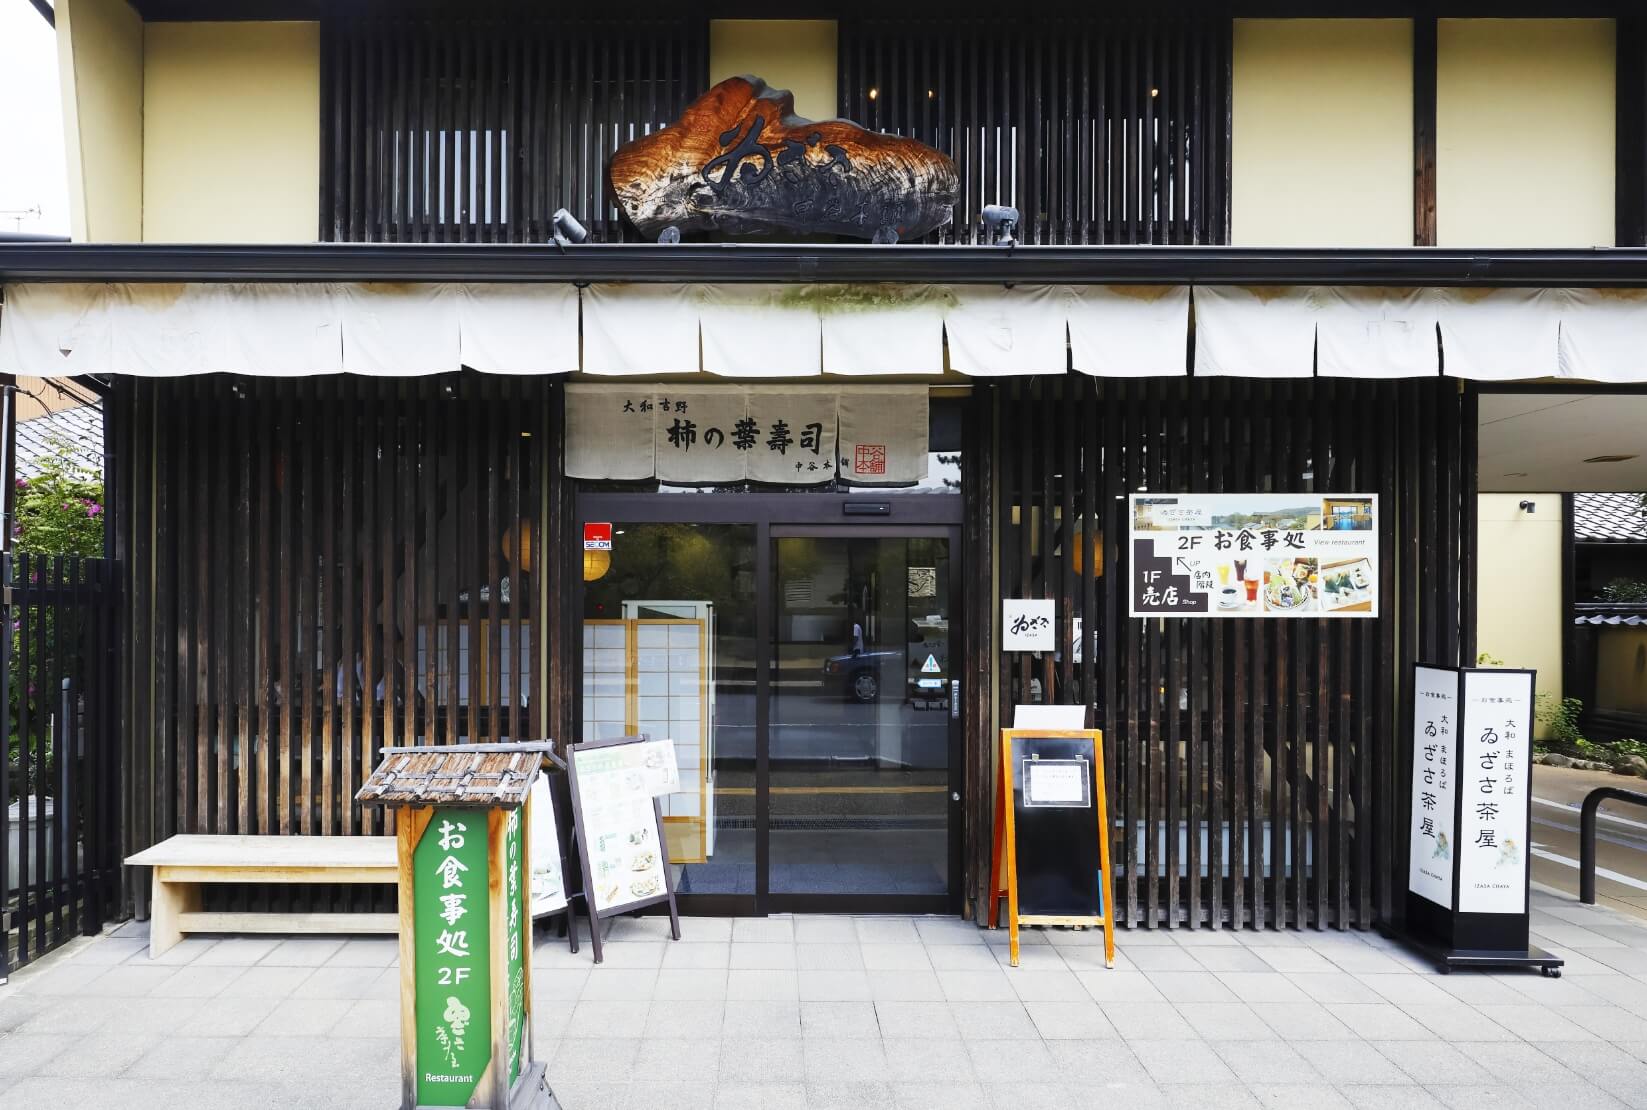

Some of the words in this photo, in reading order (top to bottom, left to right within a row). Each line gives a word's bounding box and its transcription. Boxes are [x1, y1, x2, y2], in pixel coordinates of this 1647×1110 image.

[623, 397, 688, 414] 大和吉野
[1177, 535, 1203, 550] 2F
[1213, 529, 1306, 551] お食事処
[1142, 570, 1162, 583] 1F
[1142, 585, 1178, 606] 売店
[1504, 719, 1516, 740] 大和
[1420, 720, 1438, 839] ゐざさ茶屋
[1503, 749, 1515, 795] まほろば
[1475, 727, 1500, 848] ゐざさ茶屋
[435, 819, 471, 957] お食事処
[437, 967, 471, 985] 2F
[425, 1073, 473, 1083] Restaurant
